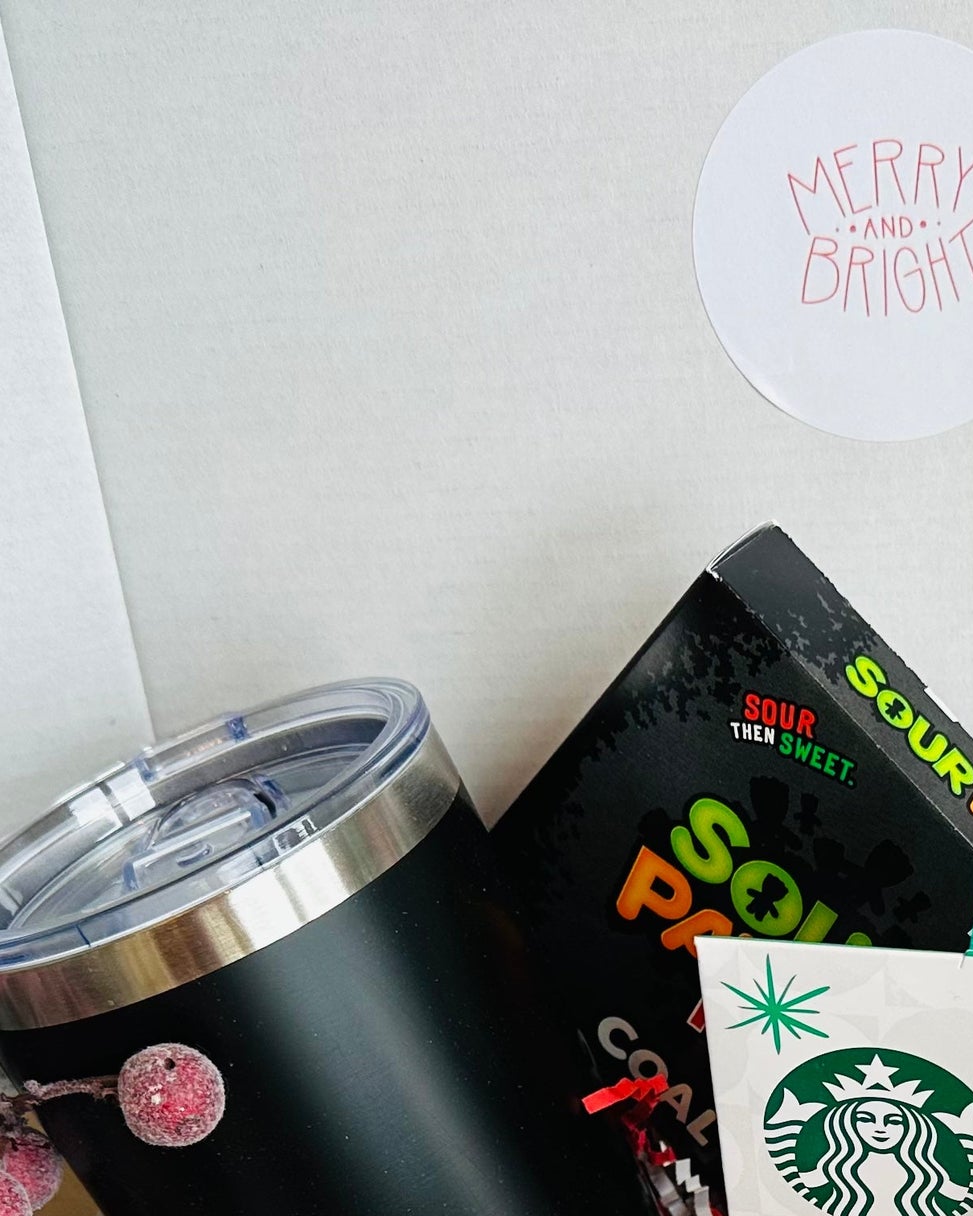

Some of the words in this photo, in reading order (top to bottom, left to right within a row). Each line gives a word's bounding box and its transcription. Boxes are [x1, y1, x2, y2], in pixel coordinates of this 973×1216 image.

[864, 216, 913, 239] AND
[744, 693, 816, 739] SOUR
[730, 721, 775, 745] THEN
[778, 732, 855, 786] SWEET.
[597, 1016, 717, 1147] COAL
